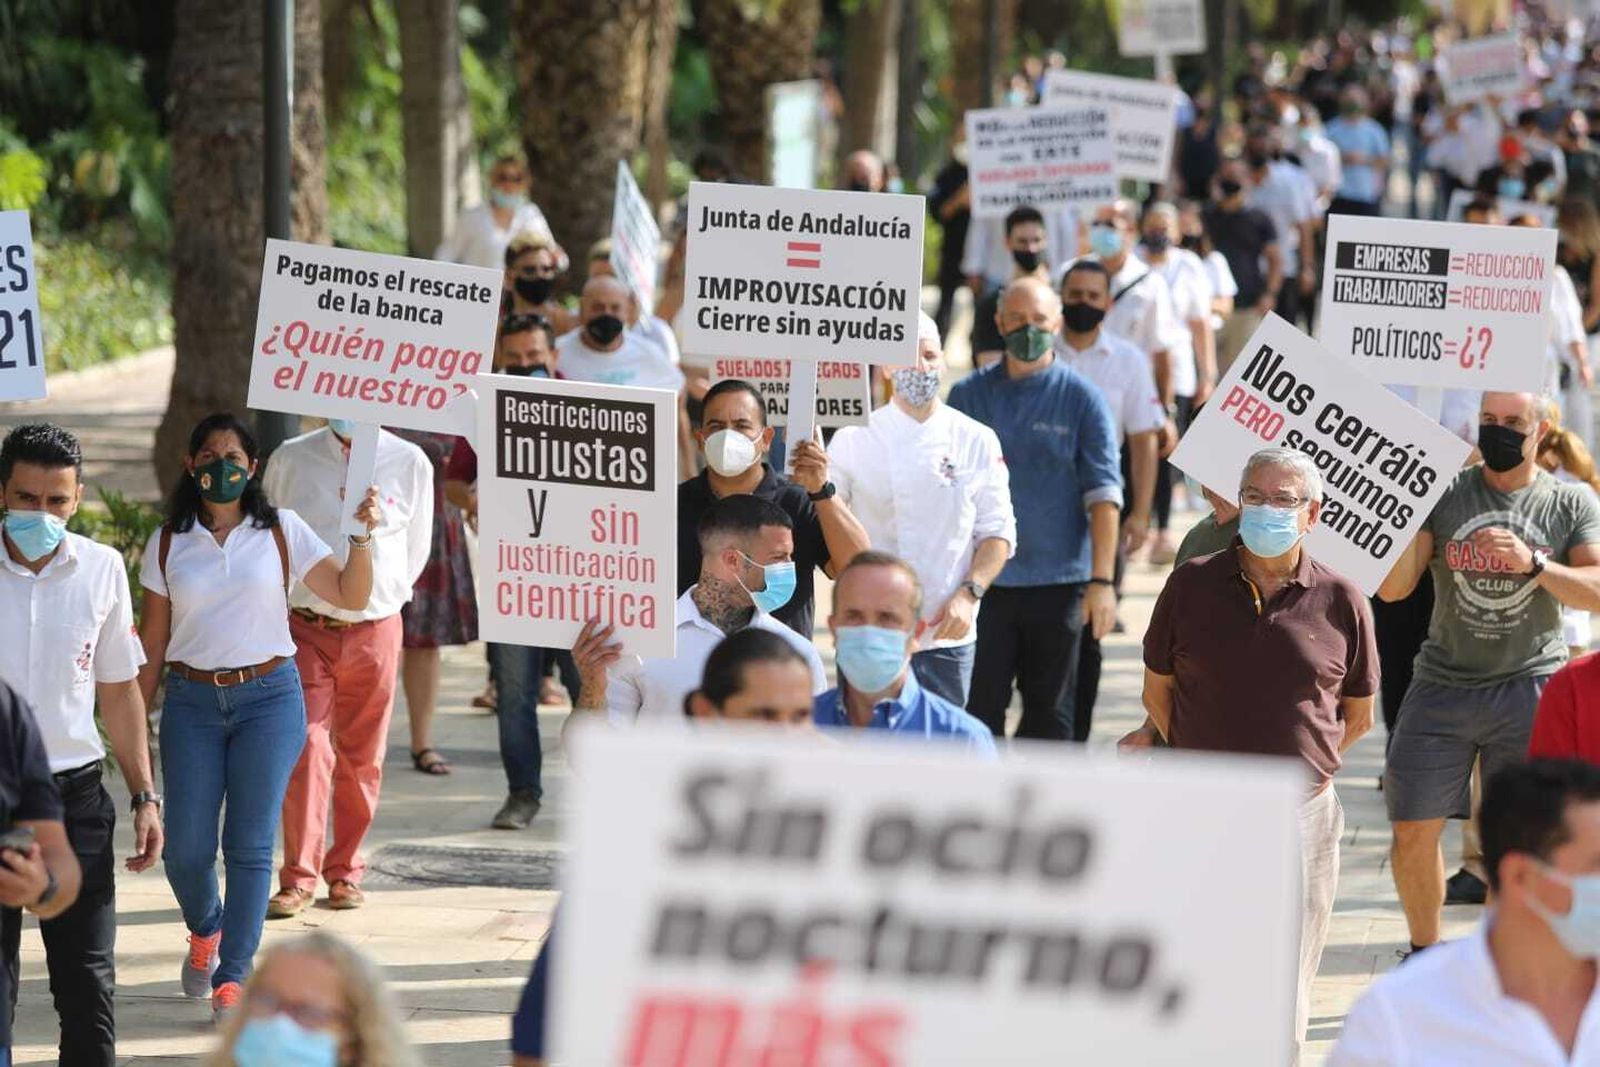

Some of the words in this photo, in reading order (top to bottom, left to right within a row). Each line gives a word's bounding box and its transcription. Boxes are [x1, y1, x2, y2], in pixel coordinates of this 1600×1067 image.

[699, 206, 761, 232] Junta
[767, 209, 793, 231] de
[799, 212, 911, 239] Andalucía
[276, 254, 379, 288] Pagamos
[384, 270, 405, 291] el
[409, 276, 492, 304] rescate
[1353, 244, 1431, 274] EMPRESAS
[318, 289, 345, 312] de
[350, 292, 370, 315] la
[376, 296, 443, 325] banca
[698, 276, 906, 311] IMPROVISACIÓN
[1335, 277, 1444, 308] TRABAJADORES
[697, 306, 770, 333] Cierre
[776, 311, 810, 335] sin
[817, 316, 905, 344] ayudas
[261, 320, 385, 360] ¿Quién
[389, 338, 483, 380] paga
[716, 360, 782, 377] SUELDOS
[273, 361, 309, 391] el
[503, 396, 647, 434] Restricciones
[1219, 384, 1285, 443] PERO
[1240, 344, 1316, 416] Nos
[1314, 402, 1437, 499] cerráis
[503, 428, 648, 484] injustas
[527, 488, 548, 538] y
[590, 503, 639, 546] sin
[497, 540, 656, 584] justificación
[496, 575, 656, 629] científica
[1475, 579, 1514, 591] CLUB
[671, 763, 827, 865] Sin
[863, 788, 1091, 881] ocio
[648, 900, 1186, 1018] nocturno,
[623, 960, 907, 1067] más
